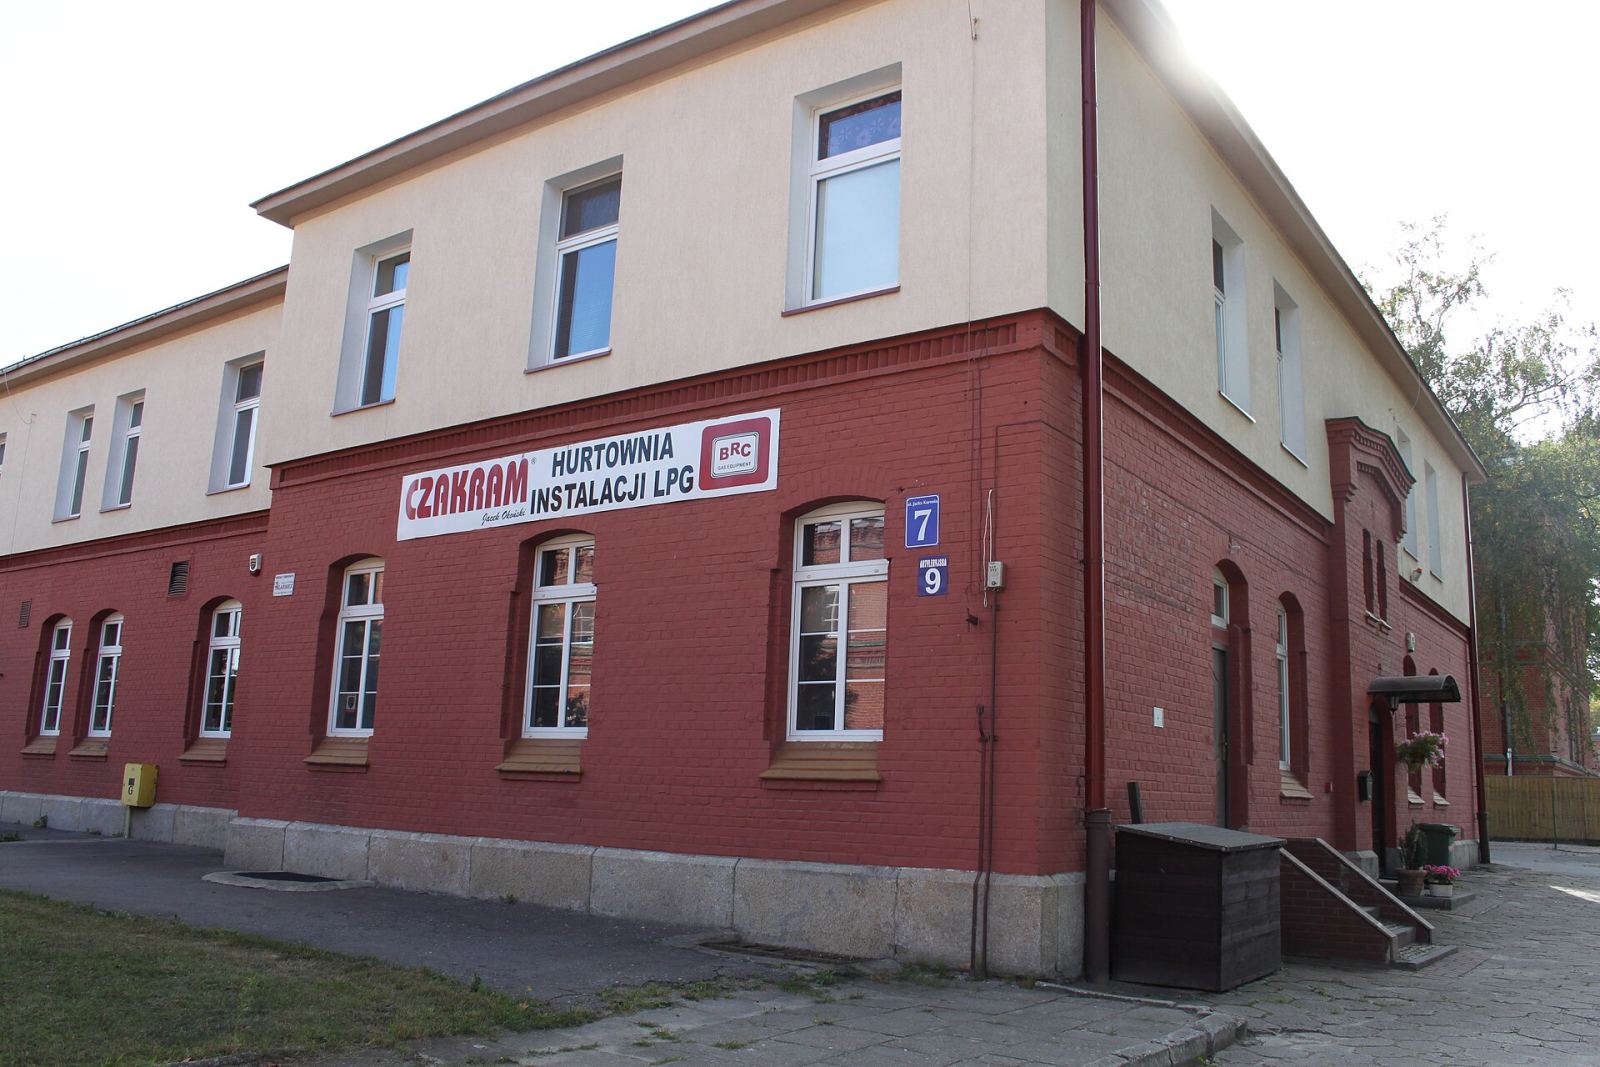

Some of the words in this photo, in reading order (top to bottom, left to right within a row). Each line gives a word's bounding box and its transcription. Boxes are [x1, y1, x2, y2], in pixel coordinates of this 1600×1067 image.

[552, 432, 674, 477] HURTOWNIA
[719, 442, 752, 461] BRC
[406, 458, 529, 520] CZAKRAM
[530, 472, 646, 515] INSTALACJI
[653, 465, 694, 498] LPG
[914, 509, 932, 541] 7
[925, 568, 941, 594] 9
[128, 785, 134, 795] G
